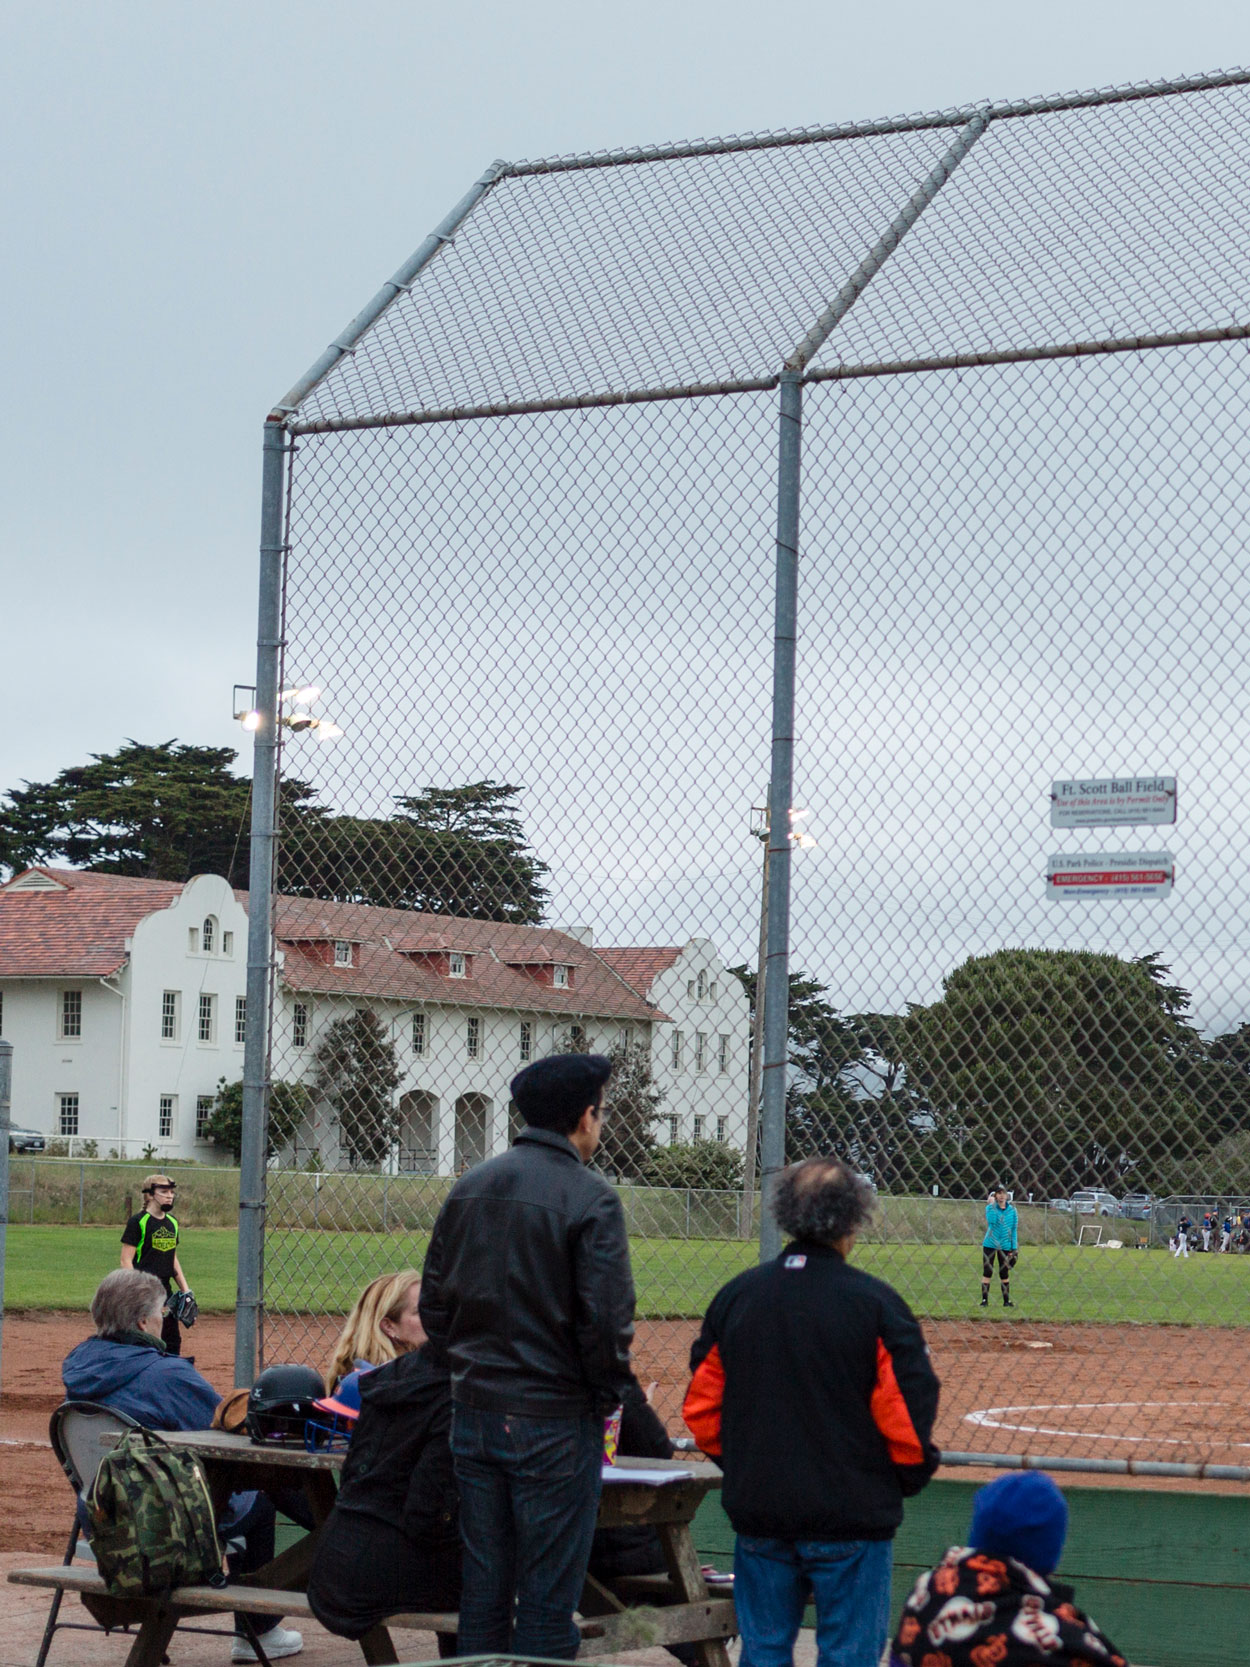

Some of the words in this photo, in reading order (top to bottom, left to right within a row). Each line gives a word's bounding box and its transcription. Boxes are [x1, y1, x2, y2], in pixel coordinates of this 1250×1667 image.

[1062, 784, 1076, 796] Ft.
[1079, 783, 1107, 795] Scott
[1111, 781, 1132, 794] Ball
[1136, 780, 1165, 793] Field
[1070, 798, 1078, 808] of
[1078, 797, 1091, 806] this
[1092, 796, 1107, 806] Area
[1116, 796, 1125, 807] by
[1126, 795, 1151, 804] Permit
[1151, 793, 1169, 805] Only
[1066, 859, 1081, 869] Park
[1083, 858, 1103, 868] Police
[1109, 857, 1138, 867] Presidio
[1139, 856, 1169, 868] Dispatch
[1055, 874, 1104, 884] EMERGENCY
